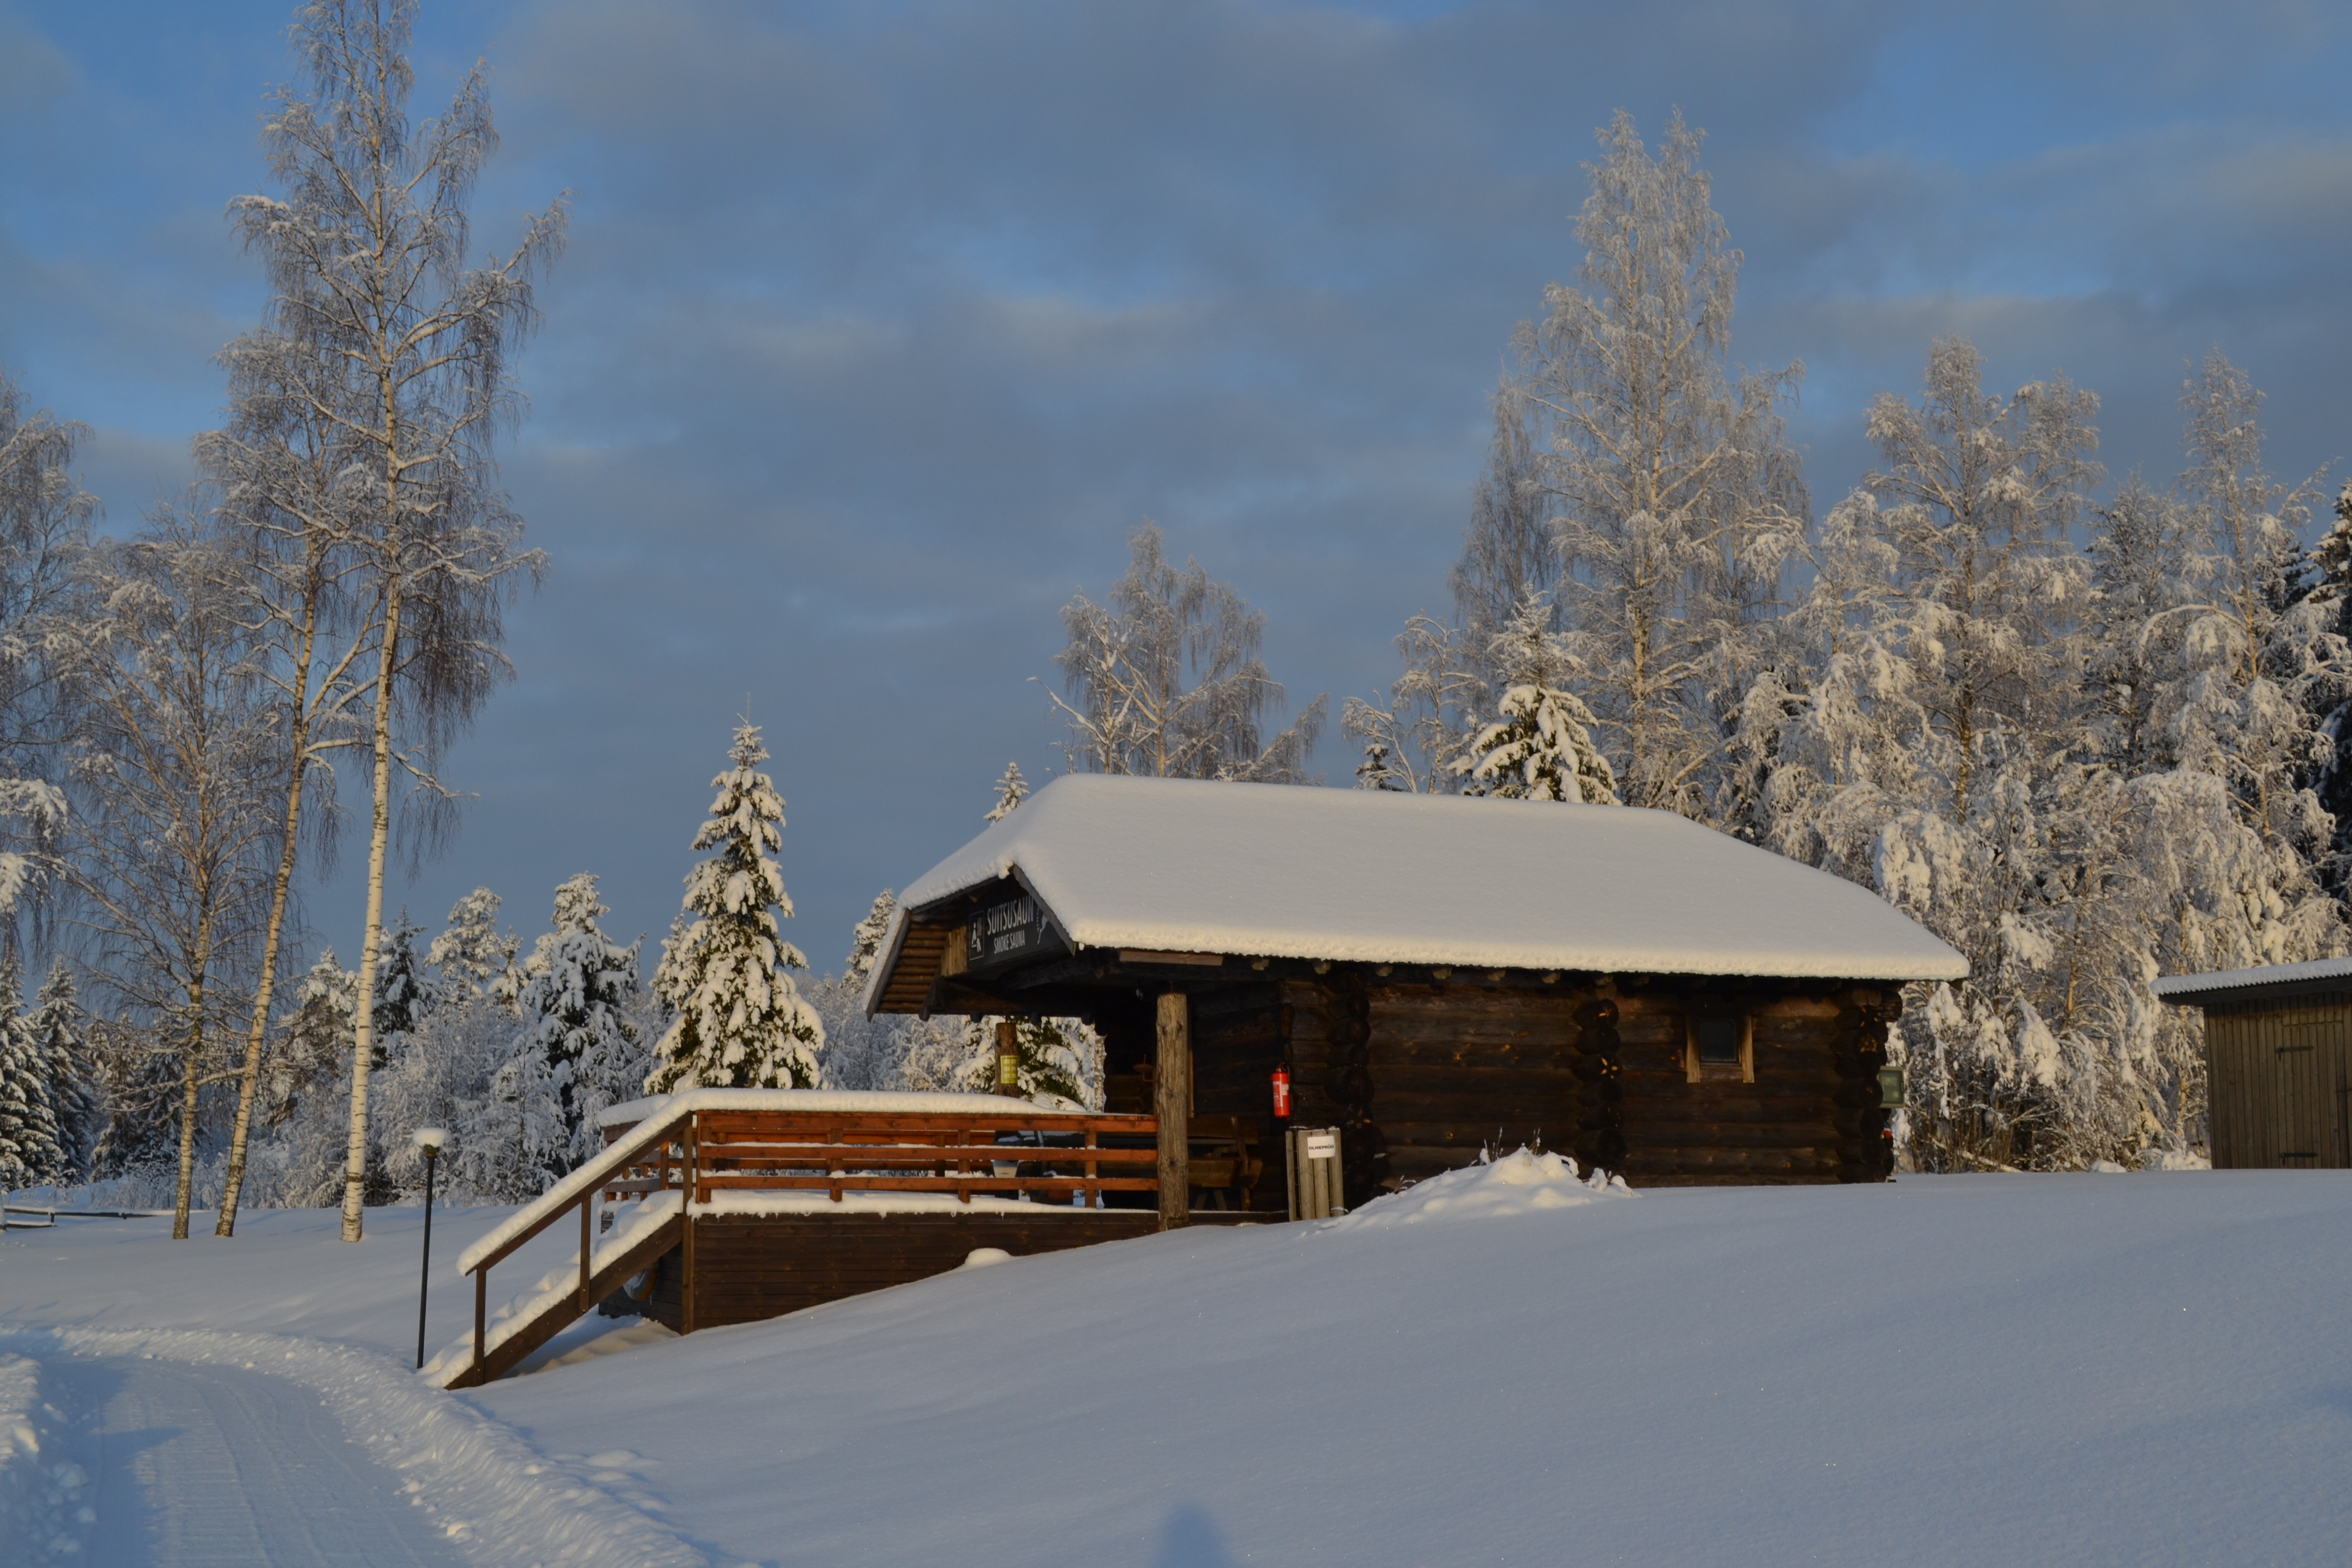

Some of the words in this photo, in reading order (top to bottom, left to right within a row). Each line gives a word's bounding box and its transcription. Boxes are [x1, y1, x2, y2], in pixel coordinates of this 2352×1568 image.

[987, 896, 1034, 935] SUITSUSAUN
[994, 935, 1009, 953] SMOKE
[1010, 929, 1025, 949] SAUNA
